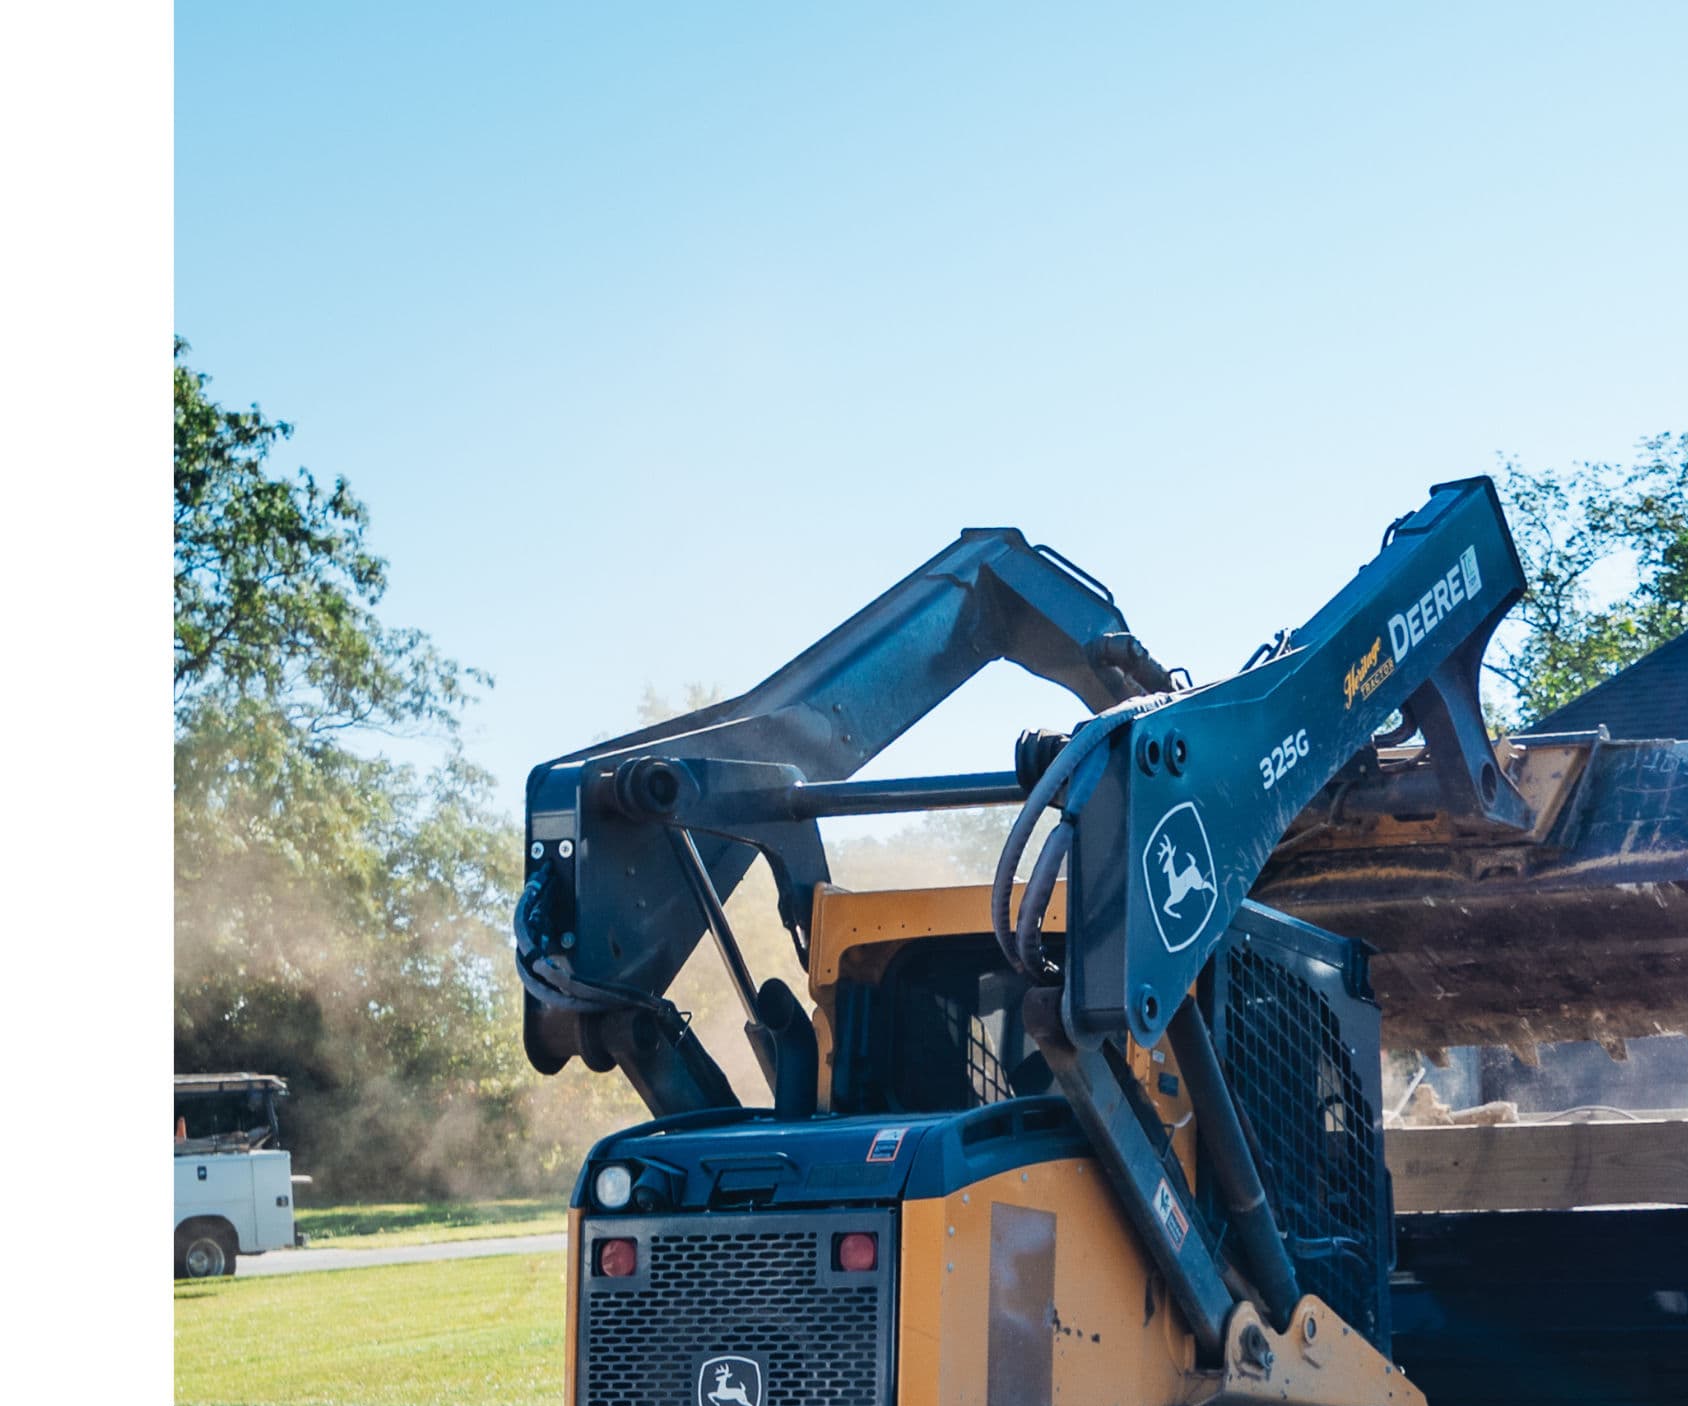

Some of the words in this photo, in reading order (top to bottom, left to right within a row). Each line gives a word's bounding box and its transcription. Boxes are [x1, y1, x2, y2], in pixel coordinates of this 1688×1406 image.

[1387, 564, 1465, 664] DEERE
[1343, 635, 1382, 710] Heritage
[1259, 728, 1310, 790] 325G
